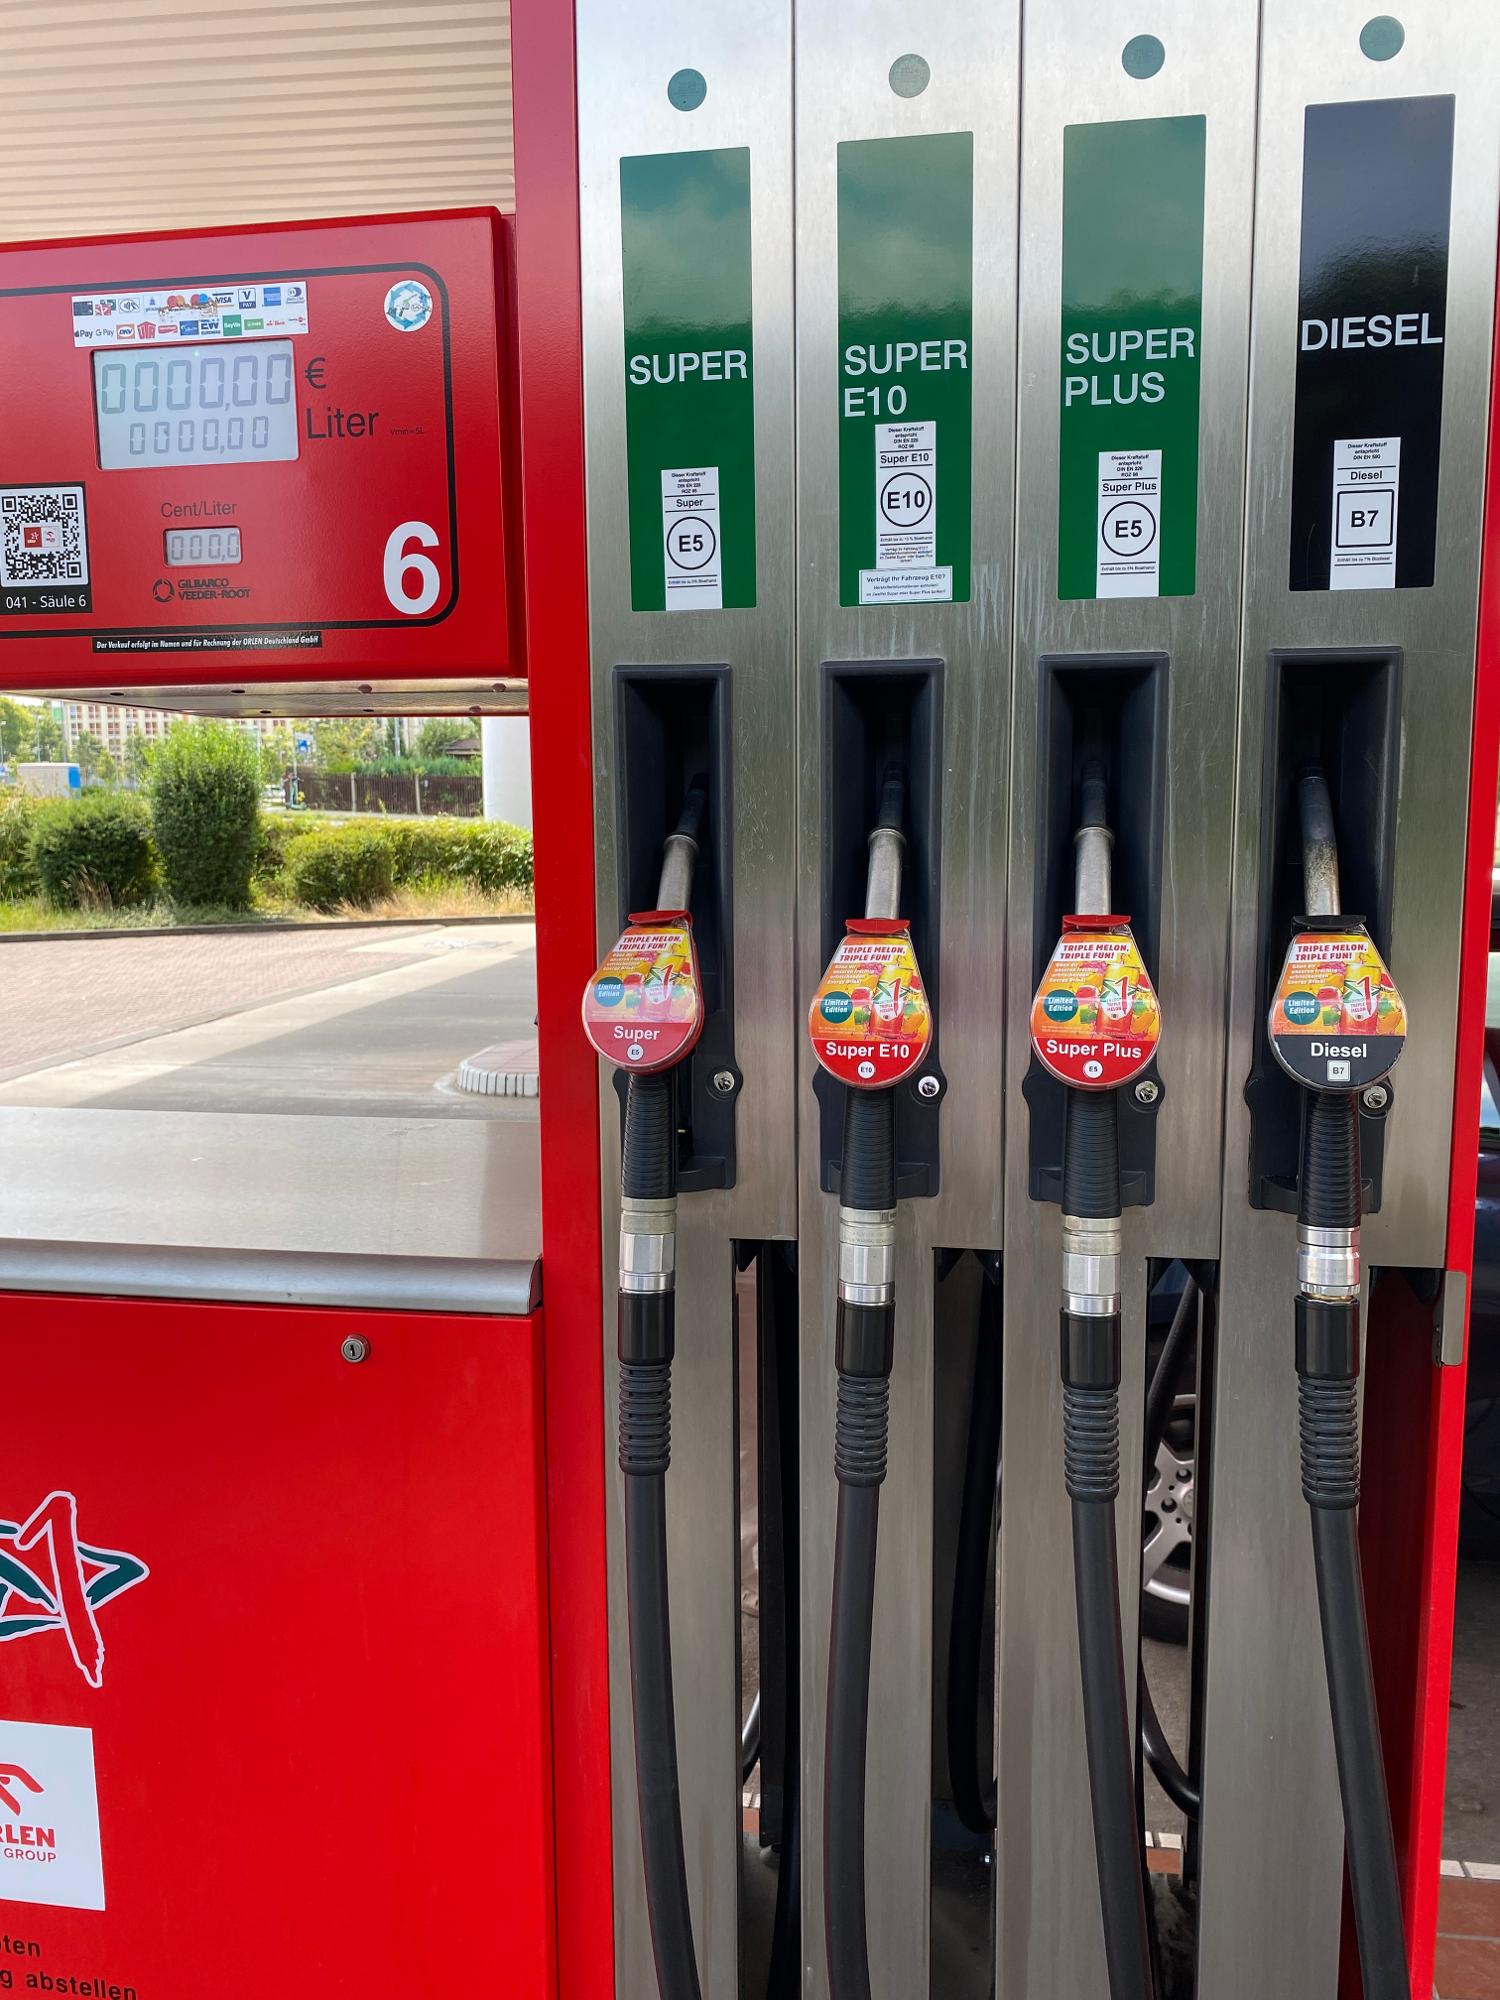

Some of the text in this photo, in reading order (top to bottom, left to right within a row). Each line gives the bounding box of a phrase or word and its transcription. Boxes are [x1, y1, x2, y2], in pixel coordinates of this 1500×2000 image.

[243, 290, 250, 300] V
[80, 330, 93, 339] Pay
[103, 329, 114, 337] Pay
[1301, 313, 1443, 351] DIESEL
[1066, 327, 1195, 364] SUPER
[844, 340, 968, 376] SUPER
[305, 357, 327, 389] €
[629, 349, 748, 385] SUPER
[1065, 372, 1165, 406] PLUS
[844, 385, 907, 417] E10
[306, 407, 379, 439] Liter
[880, 453, 929, 464] Super E10
[1351, 471, 1382, 480] Diesel
[1102, 481, 1157, 493] Super Plus
[676, 499, 704, 509] Super
[887, 490, 925, 509] E10
[161, 500, 237, 517] Cent/Liter
[1351, 510, 1379, 528] B7
[1115, 520, 1142, 538] E5
[678, 535, 704, 552] E5
[384, 521, 440, 615] 6
[178, 578, 229, 588] GILBARCO
[6, 597, 27, 609] 041
[40, 595, 75, 608] Säule
[78, 595, 86, 607] 6
[179, 589, 250, 600] VEEDER-ROOT
[108, 640, 130, 648] Verkauf
[131, 640, 150, 650] erfolgt
[160, 640, 180, 648] Namen
[181, 639, 192, 647] und
[193, 638, 202, 647] für
[203, 638, 231, 648] Rechnung
[232, 638, 242, 646] der
[242, 638, 263, 646] ORLEN
[264, 637, 300, 645] Deutschland
[300, 636, 319, 644] GmbH
[874, 946, 906, 954] MELON,
[1096, 944, 1129, 952] MELON,
[1297, 944, 1367, 952] TRIPLE MELON,
[1048, 1004, 1073, 1012] Edition
[613, 1025, 660, 1042] Super
[826, 1042, 910, 1059] Super E10
[1046, 1039, 1142, 1058] Super Plus
[1311, 1042, 1367, 1058] Diesel
[4, 1848, 56, 1862] GROUP
[26, 1971, 136, 2000] abstellen
